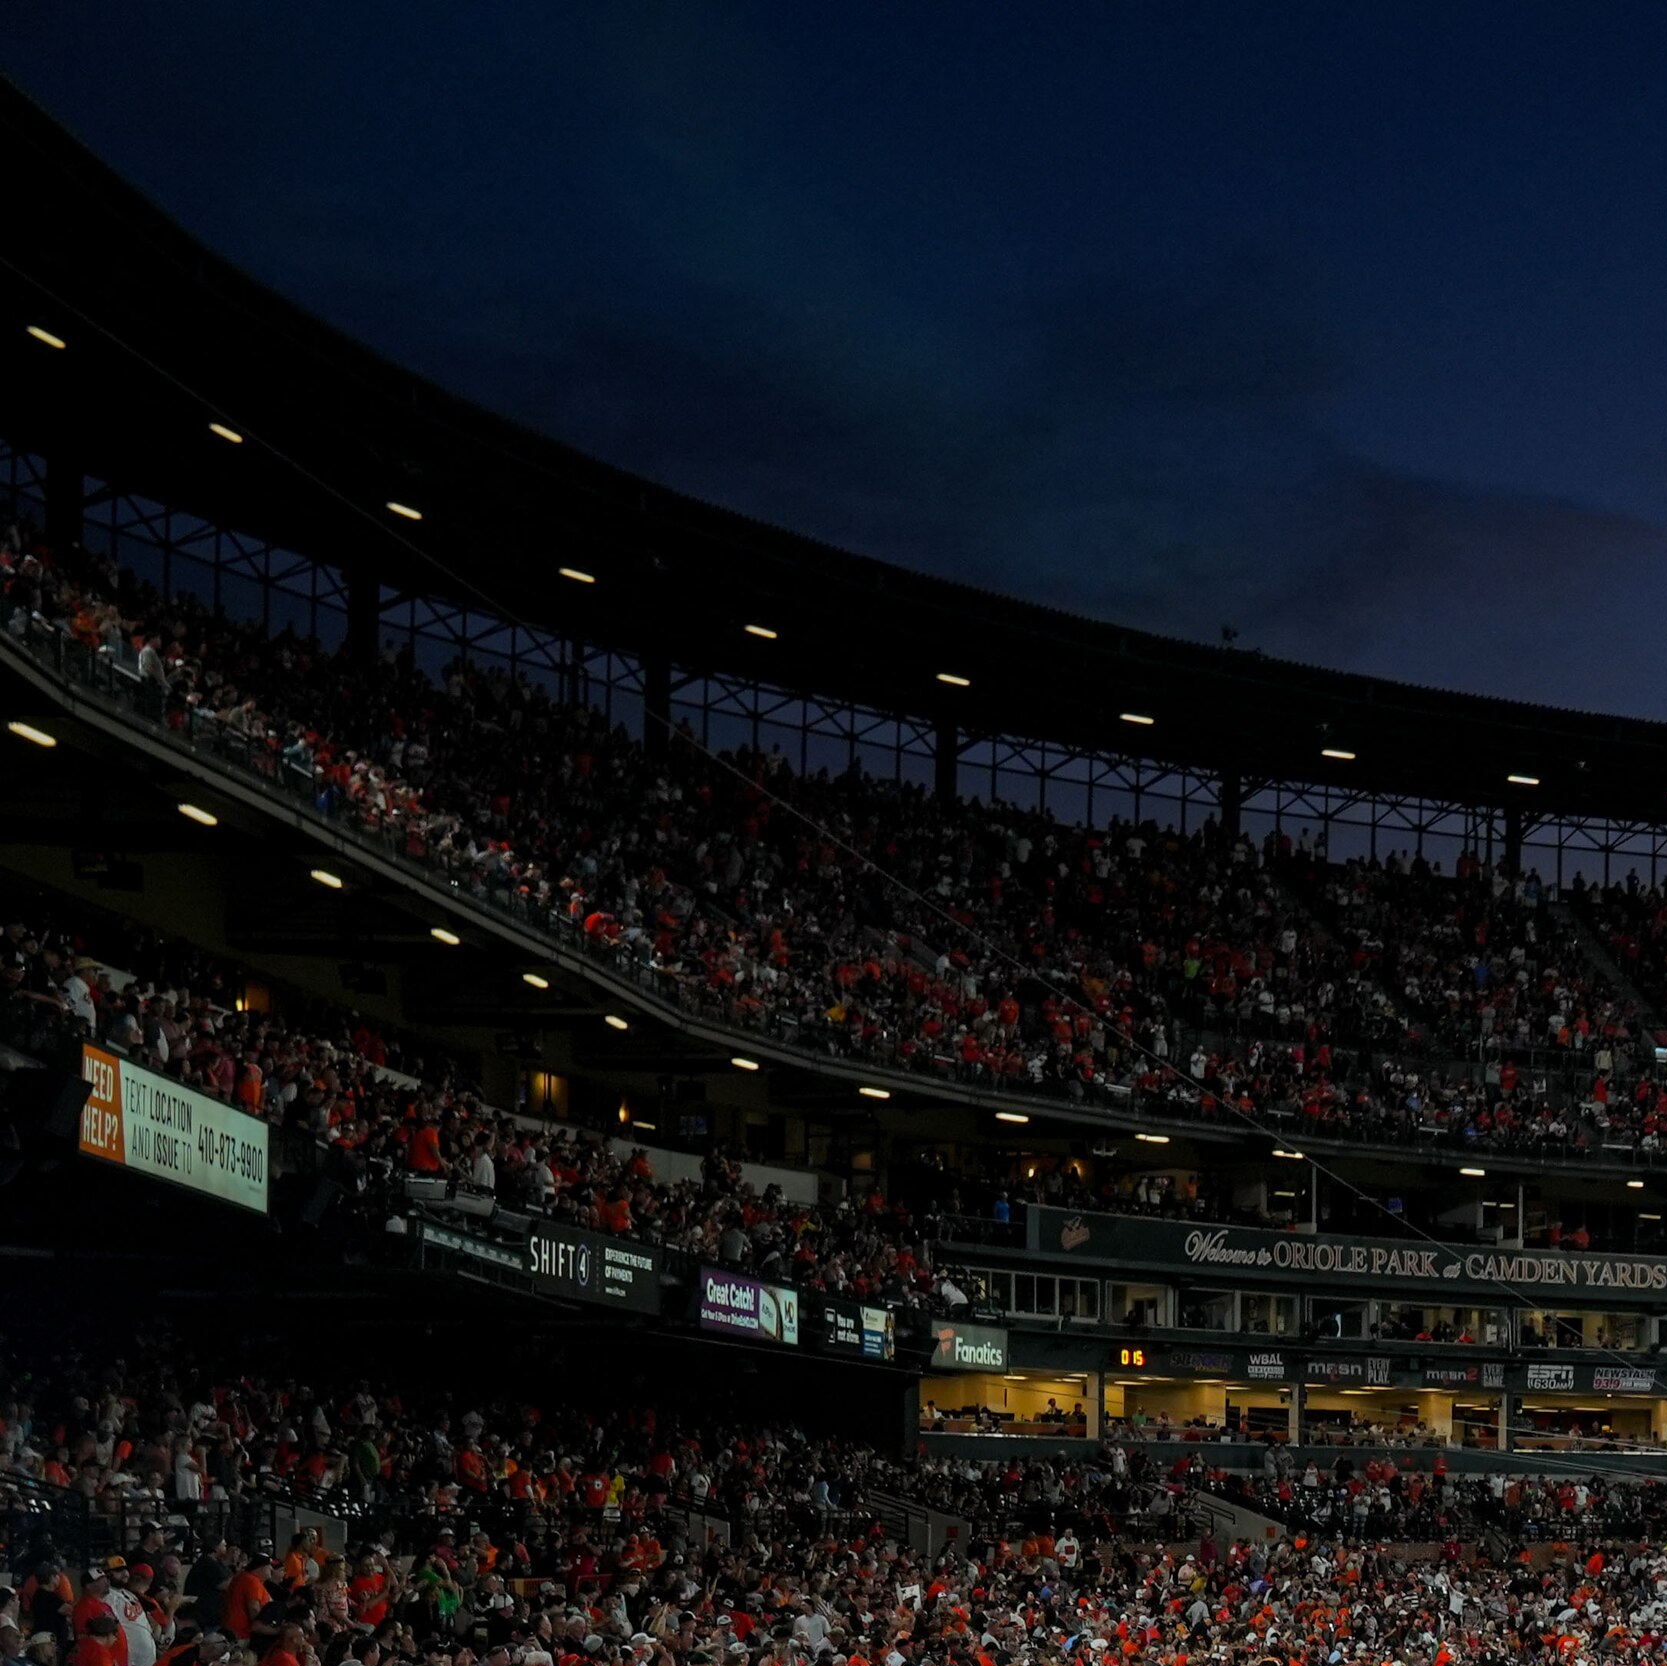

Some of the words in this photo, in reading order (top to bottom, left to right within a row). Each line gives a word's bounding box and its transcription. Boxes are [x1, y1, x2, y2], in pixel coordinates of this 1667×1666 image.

[85, 1056, 114, 1103] NEED
[125, 1077, 146, 1117] TEXT
[150, 1088, 192, 1134] LOCATION
[83, 1105, 118, 1151] HELP?
[132, 1124, 150, 1160] AND
[154, 1131, 178, 1170] ISSUE
[182, 1142, 192, 1175] TO
[199, 1123, 263, 1183] 410-873-9900
[530, 1236, 575, 1279] SHIFT
[1184, 1230, 1256, 1264] Welcome
[1257, 1248, 1272, 1266] to
[1273, 1241, 1367, 1273] ORIOLE
[1371, 1248, 1438, 1278] PARK
[1442, 1262, 1461, 1278] at
[1465, 1254, 1578, 1284] CAMDEN
[1581, 1261, 1667, 1289] YARDS
[707, 1278, 729, 1306] Great
[730, 1283, 755, 1312] Catch!
[956, 1337, 1002, 1366] Fanatics
[1121, 1350, 1129, 1366] 0
[1133, 1350, 1144, 1366] 15
[1250, 1354, 1283, 1366] WBAL
[1368, 1358, 1390, 1370] EVERY
[1528, 1365, 1574, 1379] ESPN
